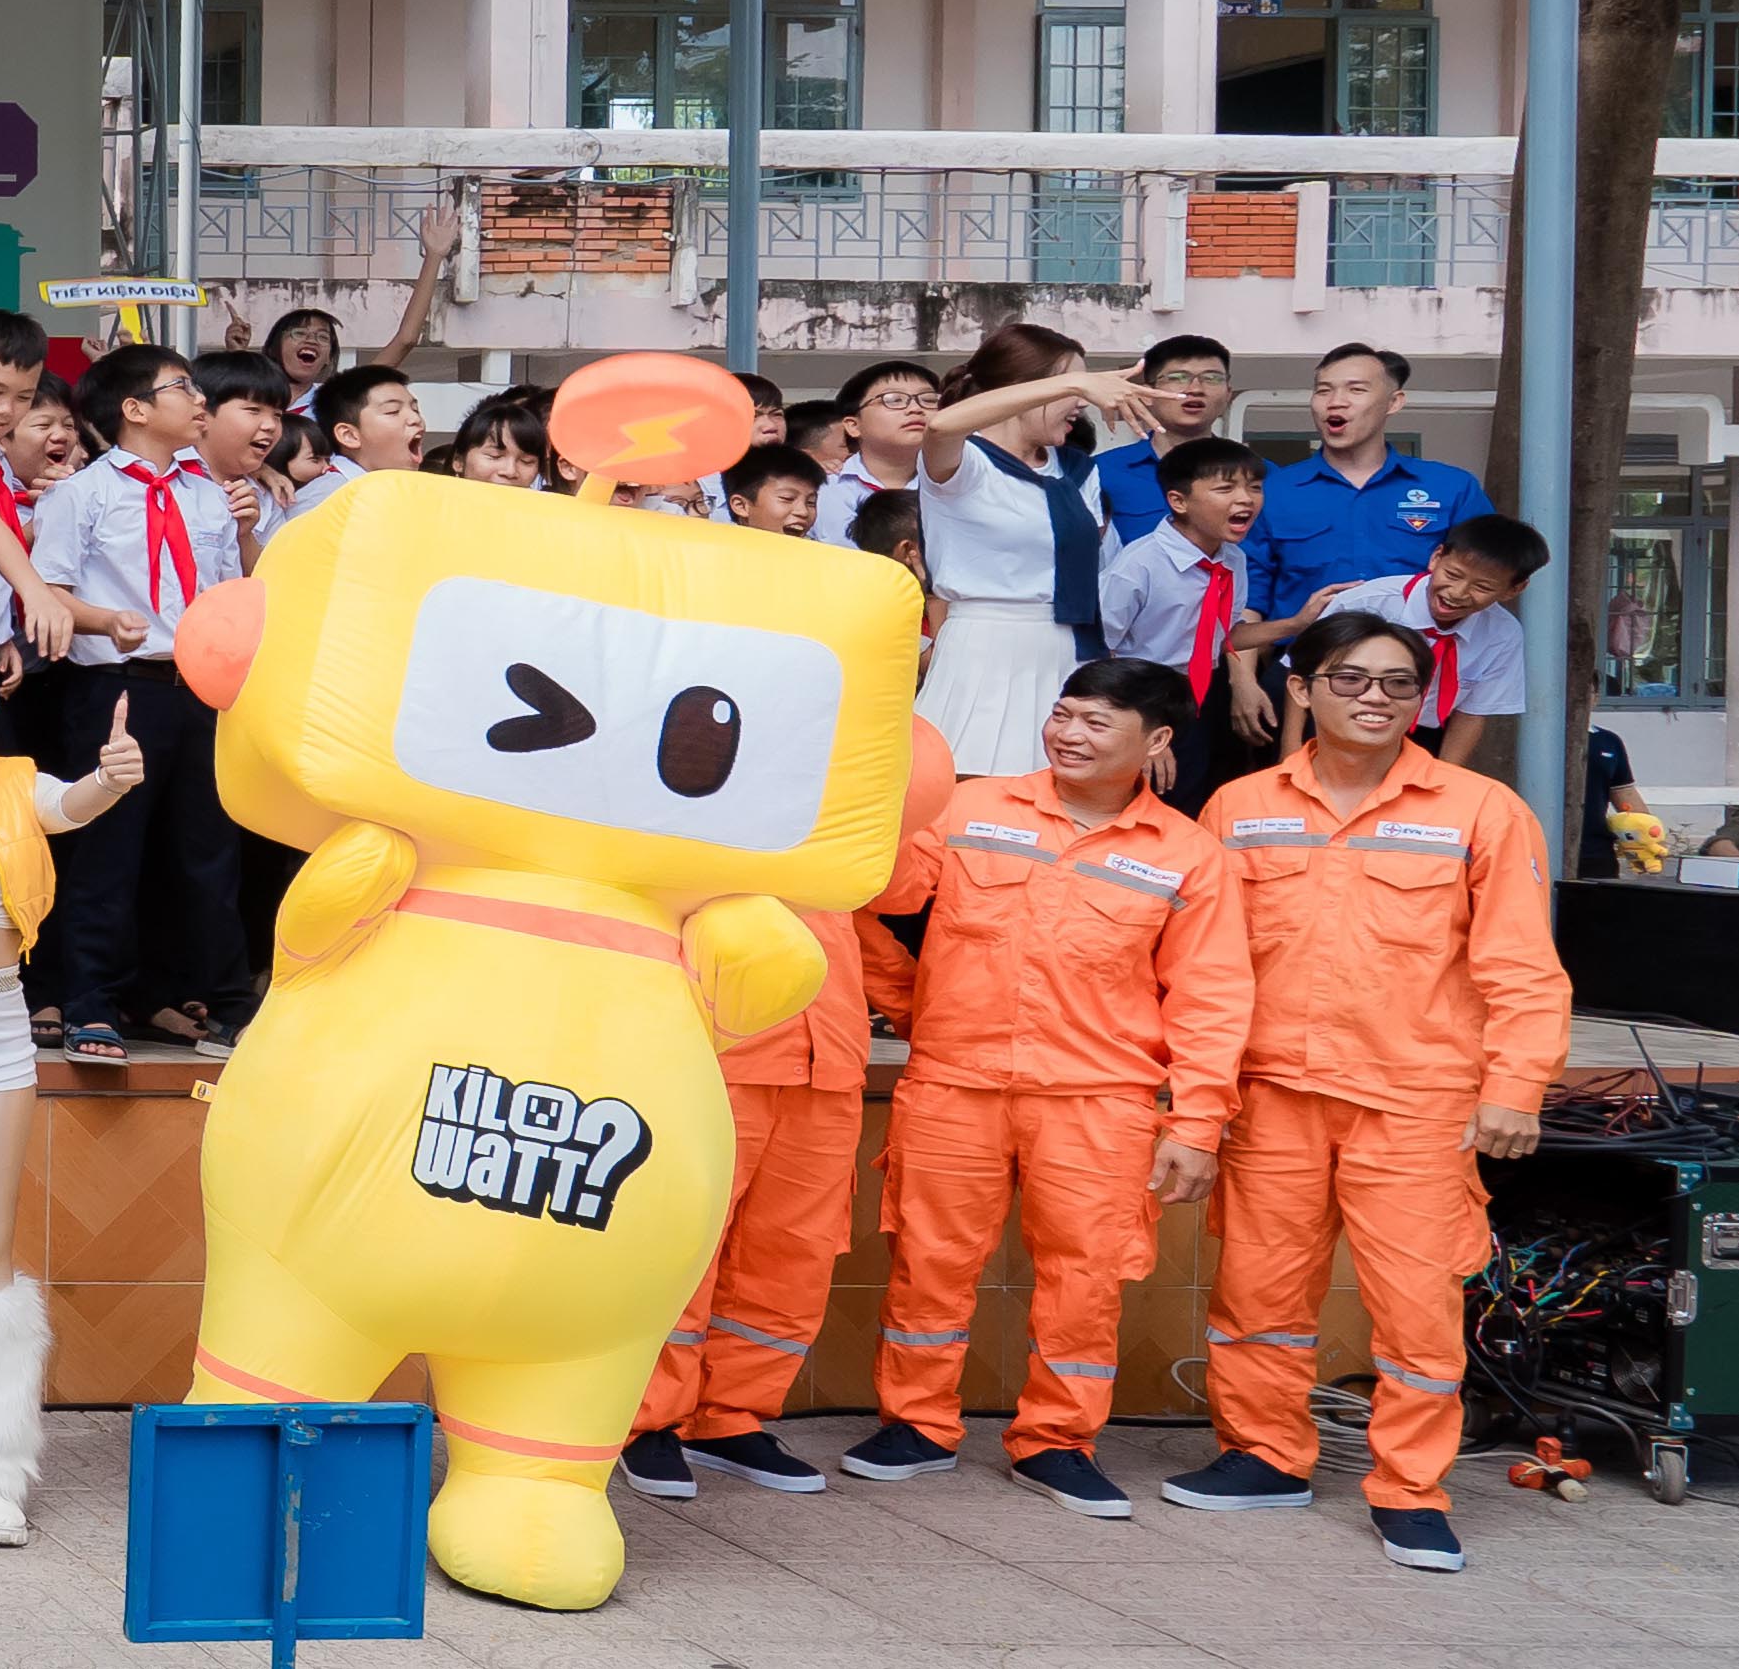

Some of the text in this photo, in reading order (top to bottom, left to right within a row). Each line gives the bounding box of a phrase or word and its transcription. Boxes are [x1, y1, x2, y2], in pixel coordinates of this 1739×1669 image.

[51, 283, 196, 300] TIẾT KIỆM ĐIỆN
